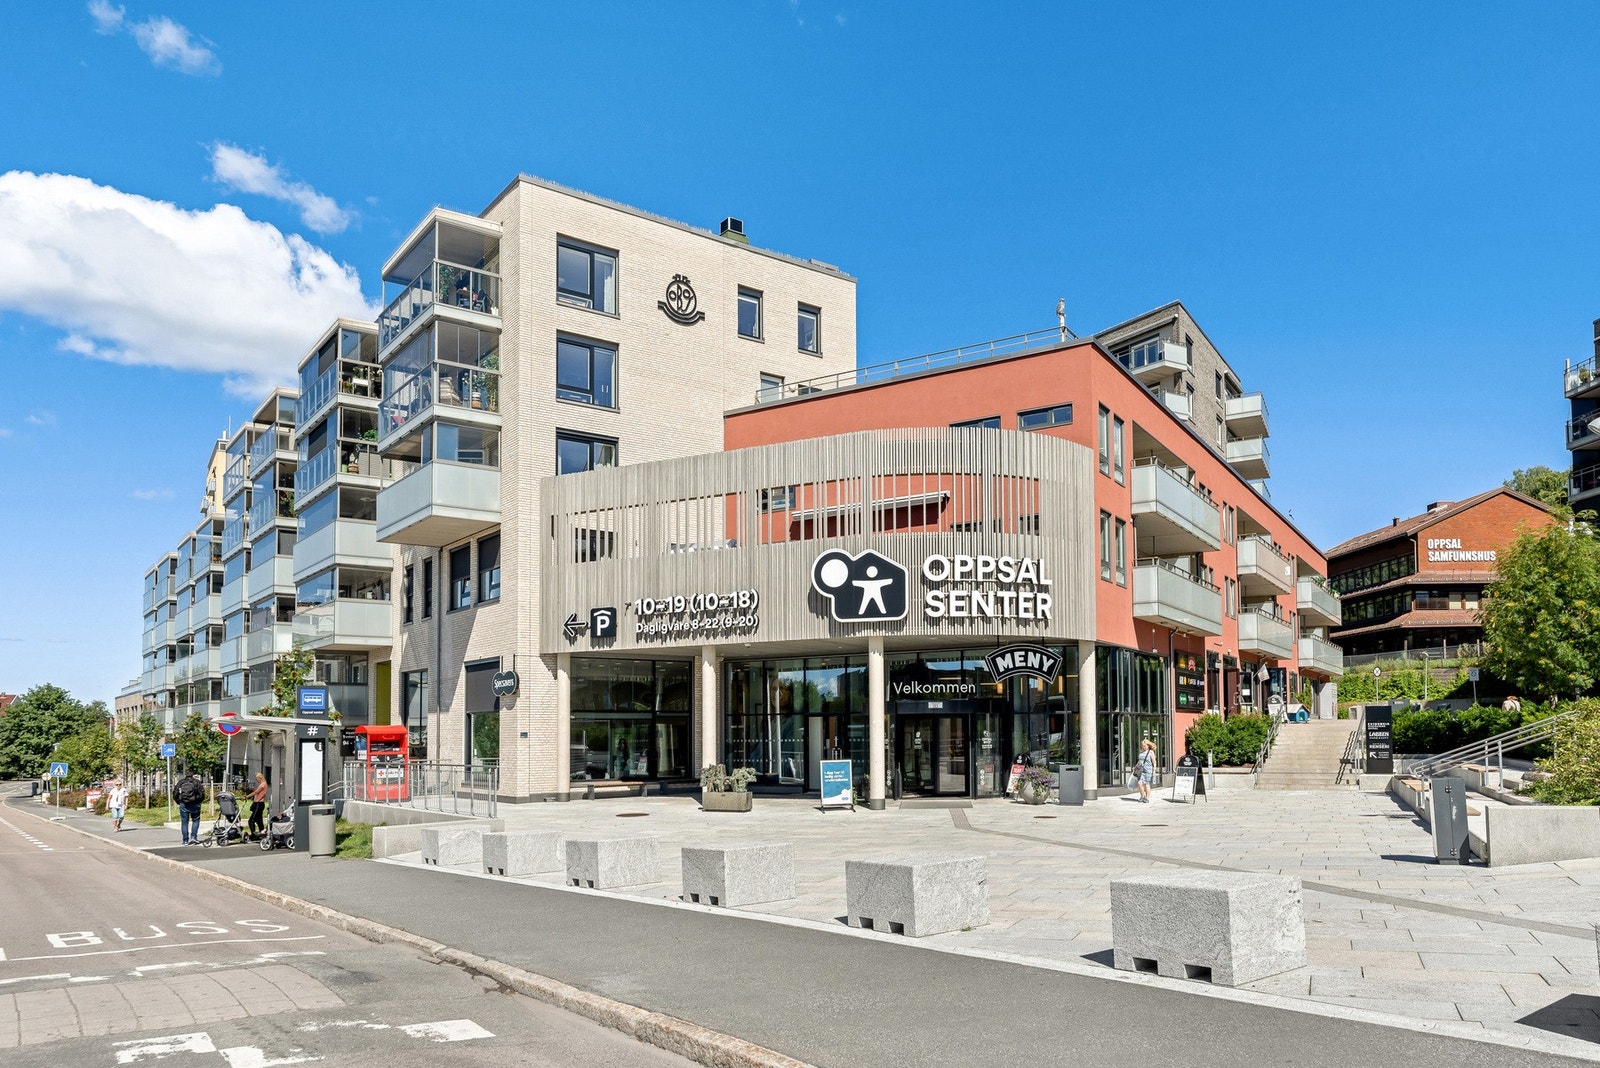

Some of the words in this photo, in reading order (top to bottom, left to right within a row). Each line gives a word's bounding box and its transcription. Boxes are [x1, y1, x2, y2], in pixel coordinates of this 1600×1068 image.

[1427, 538, 1462, 550] OPPSAL
[1428, 550, 1497, 562] SAMFUNNSHUS
[923, 554, 1053, 585] OPPSAL
[924, 590, 1053, 620] SENTER
[636, 621, 690, 635] Dagligvare
[995, 651, 1055, 673] MENY
[893, 681, 976, 695] Velkommen
[45, 919, 290, 948] BUSS
